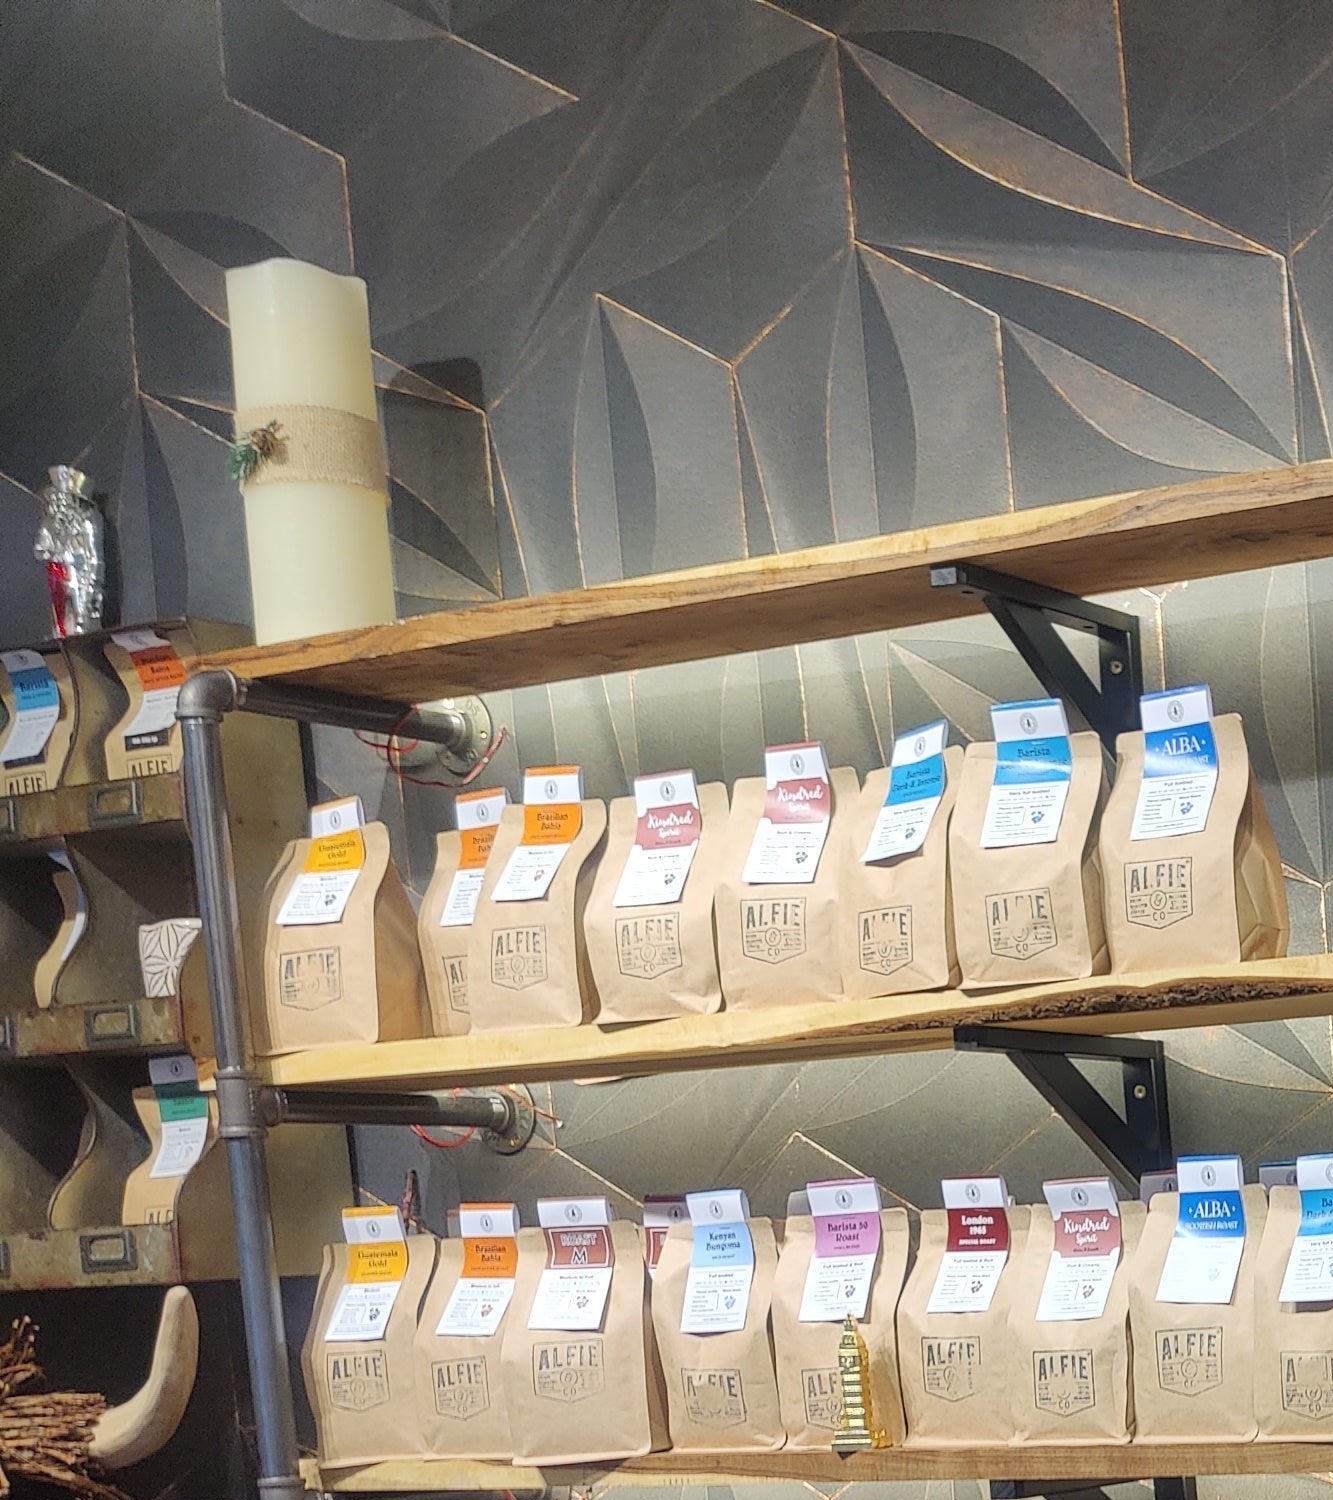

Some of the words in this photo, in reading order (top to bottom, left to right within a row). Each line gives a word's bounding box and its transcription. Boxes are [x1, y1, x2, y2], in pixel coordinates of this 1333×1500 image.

[1017, 745, 1051, 757] Barista
[1161, 736, 1201, 757] ALBA
[778, 785, 824, 800] Kindred
[648, 808, 694, 828] Kindred
[1130, 864, 1186, 893] ALFIE
[746, 902, 800, 929] ALFIE
[621, 919, 674, 948] ALFIE
[496, 932, 542, 957] ALFIE
[1194, 1201, 1231, 1219] ALBA
[827, 1222, 857, 1232] Barista
[961, 1215, 994, 1226] London
[1063, 1217, 1109, 1233] Kindred
[560, 1233, 597, 1247] ROAST
[709, 1232, 736, 1242] Kenyan
[835, 1232, 859, 1241] Roast
[1076, 1233, 1097, 1244] Spirit
[706, 1241, 741, 1252] Bungoma
[369, 1259, 387, 1268] Gold
[572, 1247, 588, 1265] M
[927, 1342, 975, 1367] ALFIE
[1162, 1334, 1217, 1360] ALFIE
[538, 1345, 598, 1371] ALFIE
[332, 1357, 383, 1380] ALFIE
[436, 1363, 482, 1389] ALFIE
[1038, 1355, 1088, 1382] ALFIE
